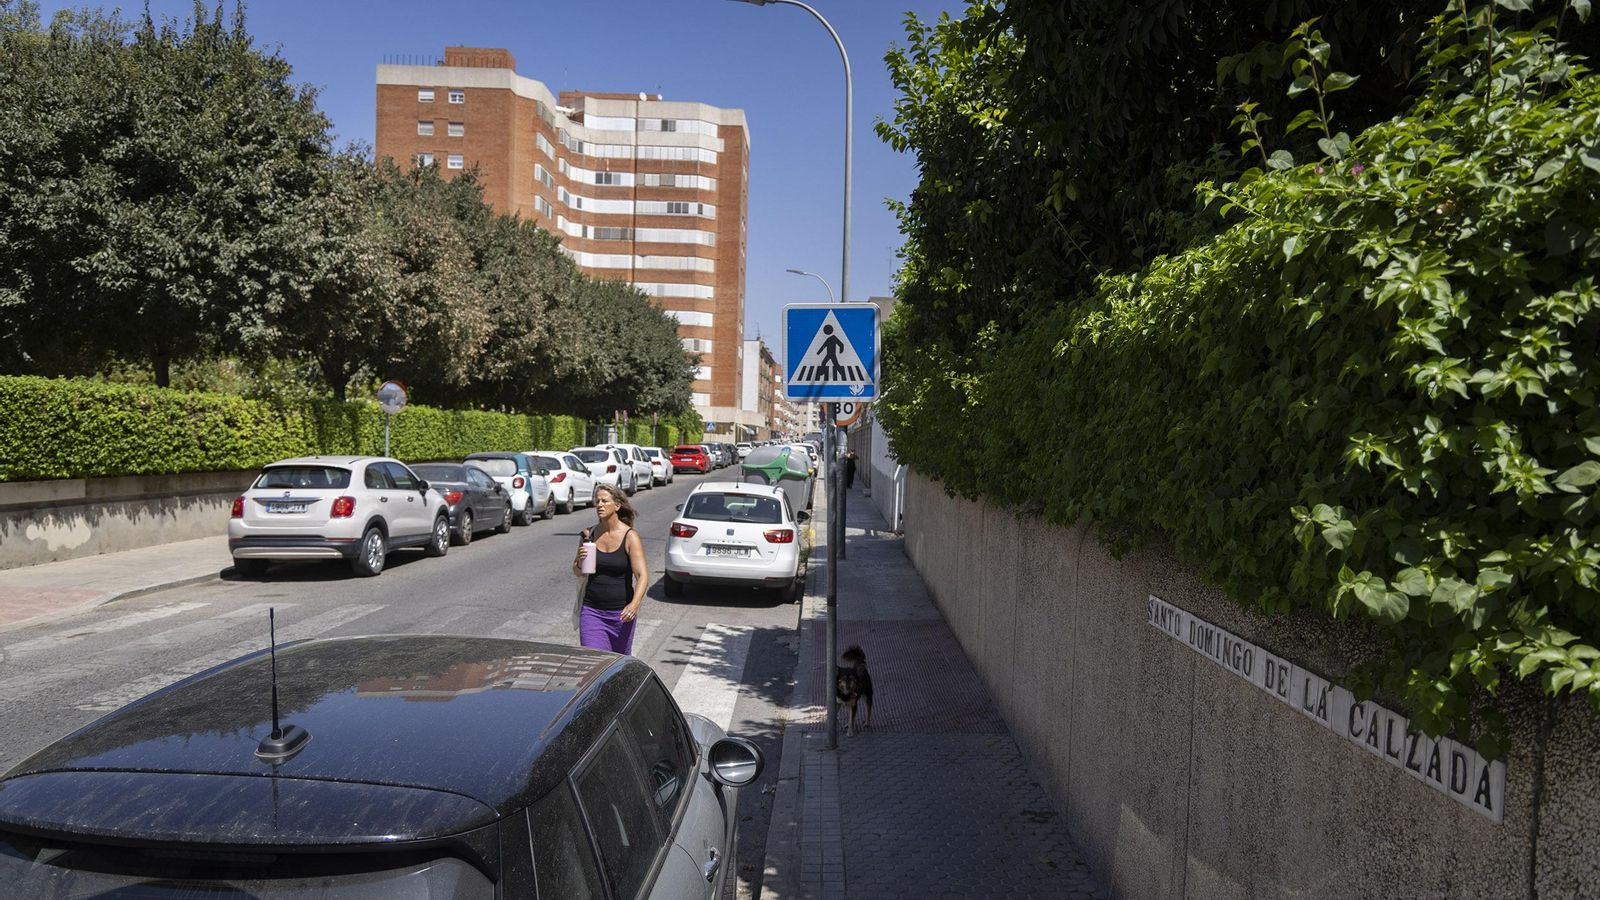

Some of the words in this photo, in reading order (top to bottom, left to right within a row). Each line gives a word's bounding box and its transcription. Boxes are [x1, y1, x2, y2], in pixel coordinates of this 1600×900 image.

[1148, 599, 1180, 637] SANTO
[1189, 620, 1252, 677] DOMINGO
[1264, 658, 1288, 698] DE
[1303, 678, 1327, 721] LA
[1349, 703, 1492, 812] CALZADA
